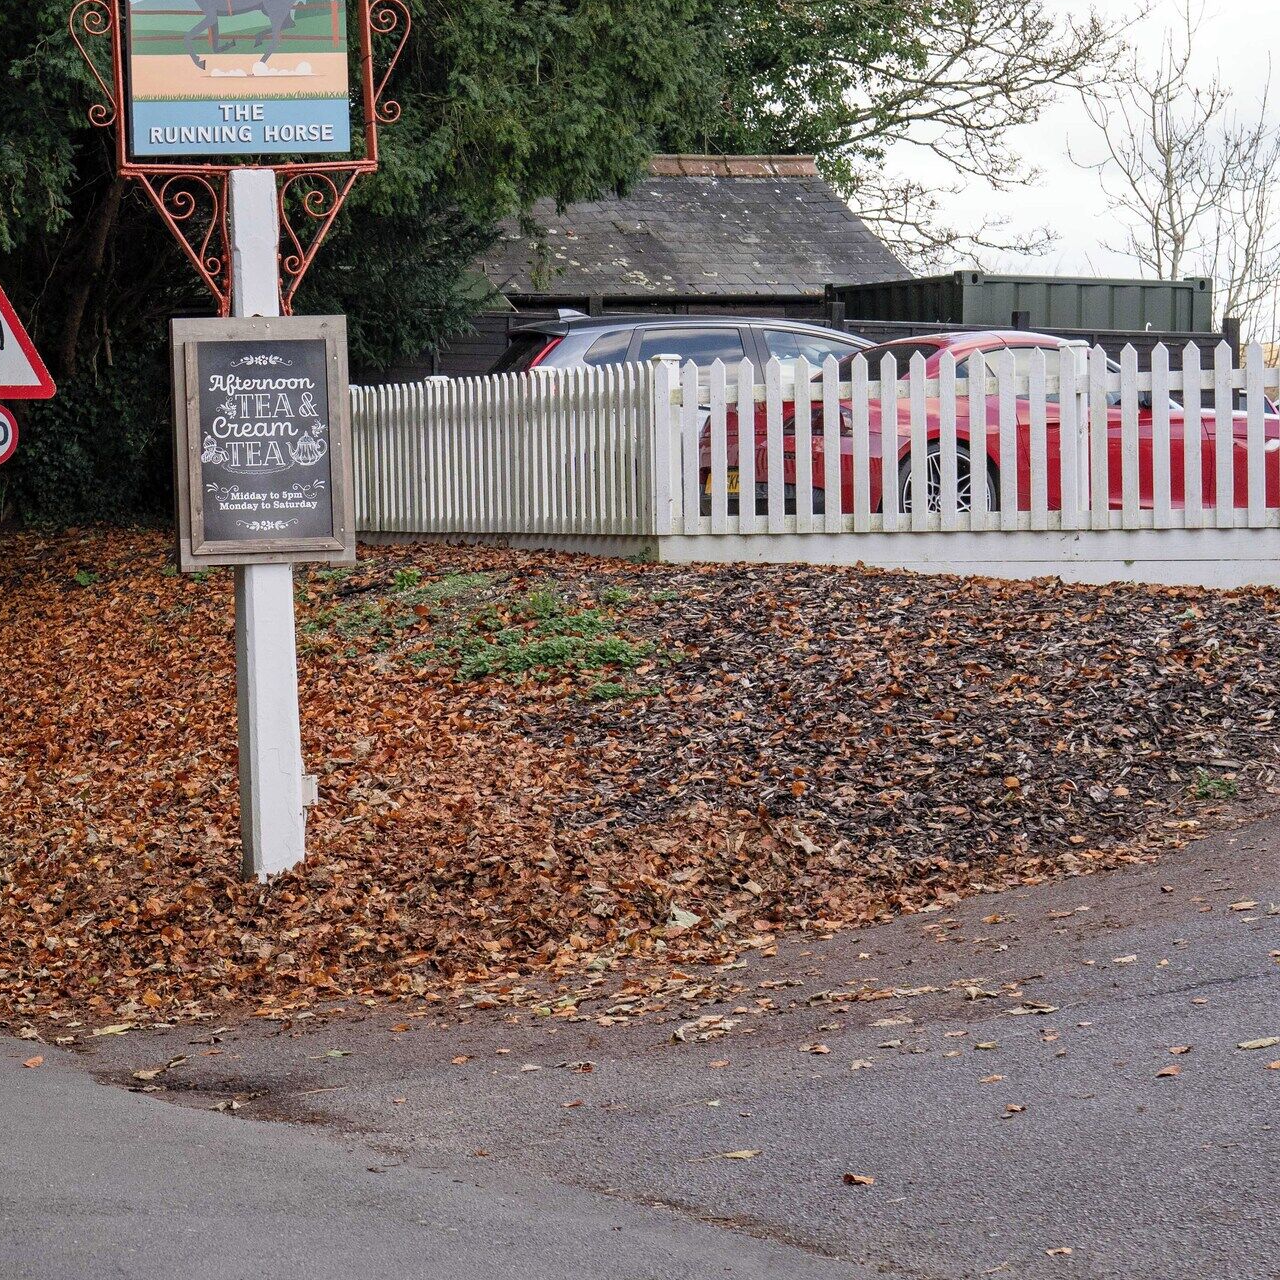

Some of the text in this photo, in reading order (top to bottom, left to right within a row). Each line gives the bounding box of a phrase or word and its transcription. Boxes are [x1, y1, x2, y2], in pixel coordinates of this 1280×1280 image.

[218, 104, 265, 122] THE
[149, 124, 334, 144] RUNNING HORSE
[208, 373, 315, 396] Afternoon
[235, 391, 320, 419] TEA &
[212, 416, 299, 439] Cream
[225, 441, 287, 467] TEA
[219, 500, 318, 511] Monday to Saturday
[230, 490, 303, 501] Midday to 5pm
